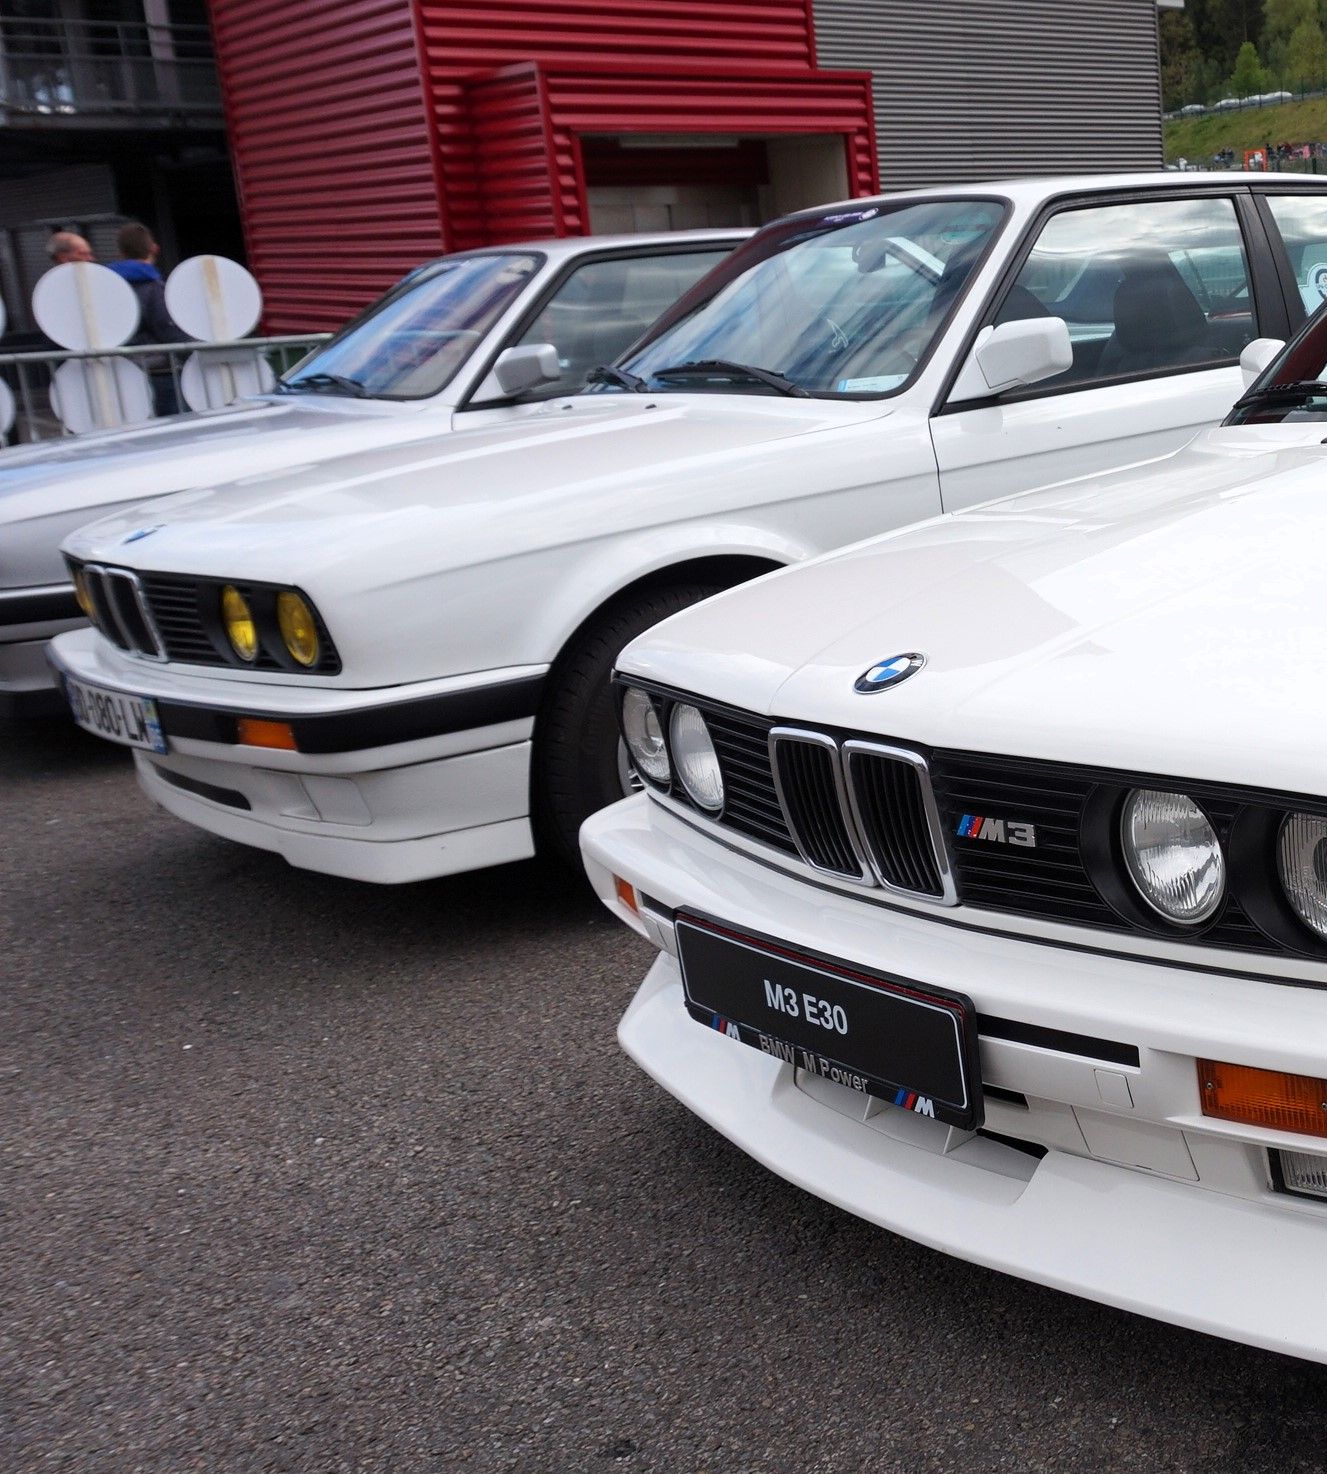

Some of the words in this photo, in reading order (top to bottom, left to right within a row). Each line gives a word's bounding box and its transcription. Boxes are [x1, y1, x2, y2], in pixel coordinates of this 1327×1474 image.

[978, 817, 1036, 848] M3
[763, 979, 799, 1017] M3
[802, 993, 848, 1036] E30
[758, 1033, 797, 1066] BMW
[802, 1051, 816, 1074] M
[820, 1057, 869, 1093] Power
